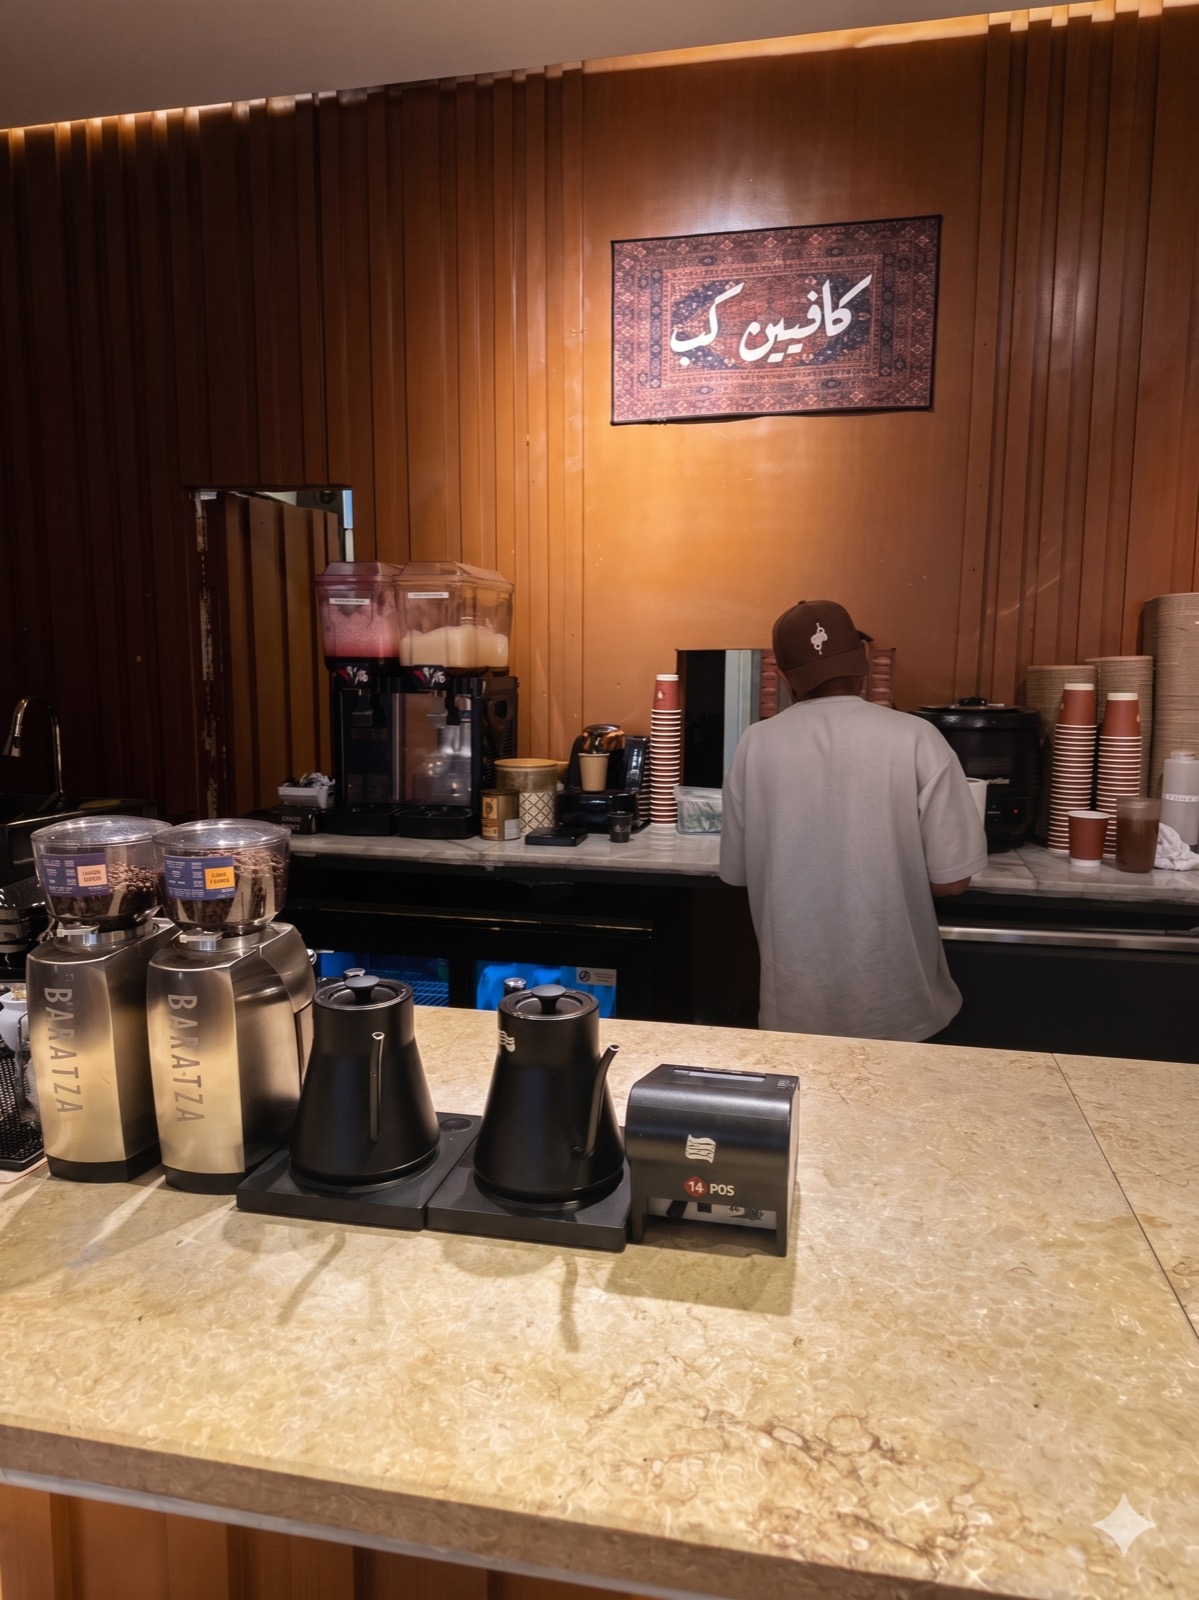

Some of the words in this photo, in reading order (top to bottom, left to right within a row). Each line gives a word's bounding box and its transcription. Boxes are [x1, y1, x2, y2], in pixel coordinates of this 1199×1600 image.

[670, 282, 744, 367] كب
[44, 987, 84, 1113] BARATZA
[167, 994, 205, 1122] BARATZA
[688, 1181, 704, 1194] 14
[709, 1183, 735, 1197] POS
